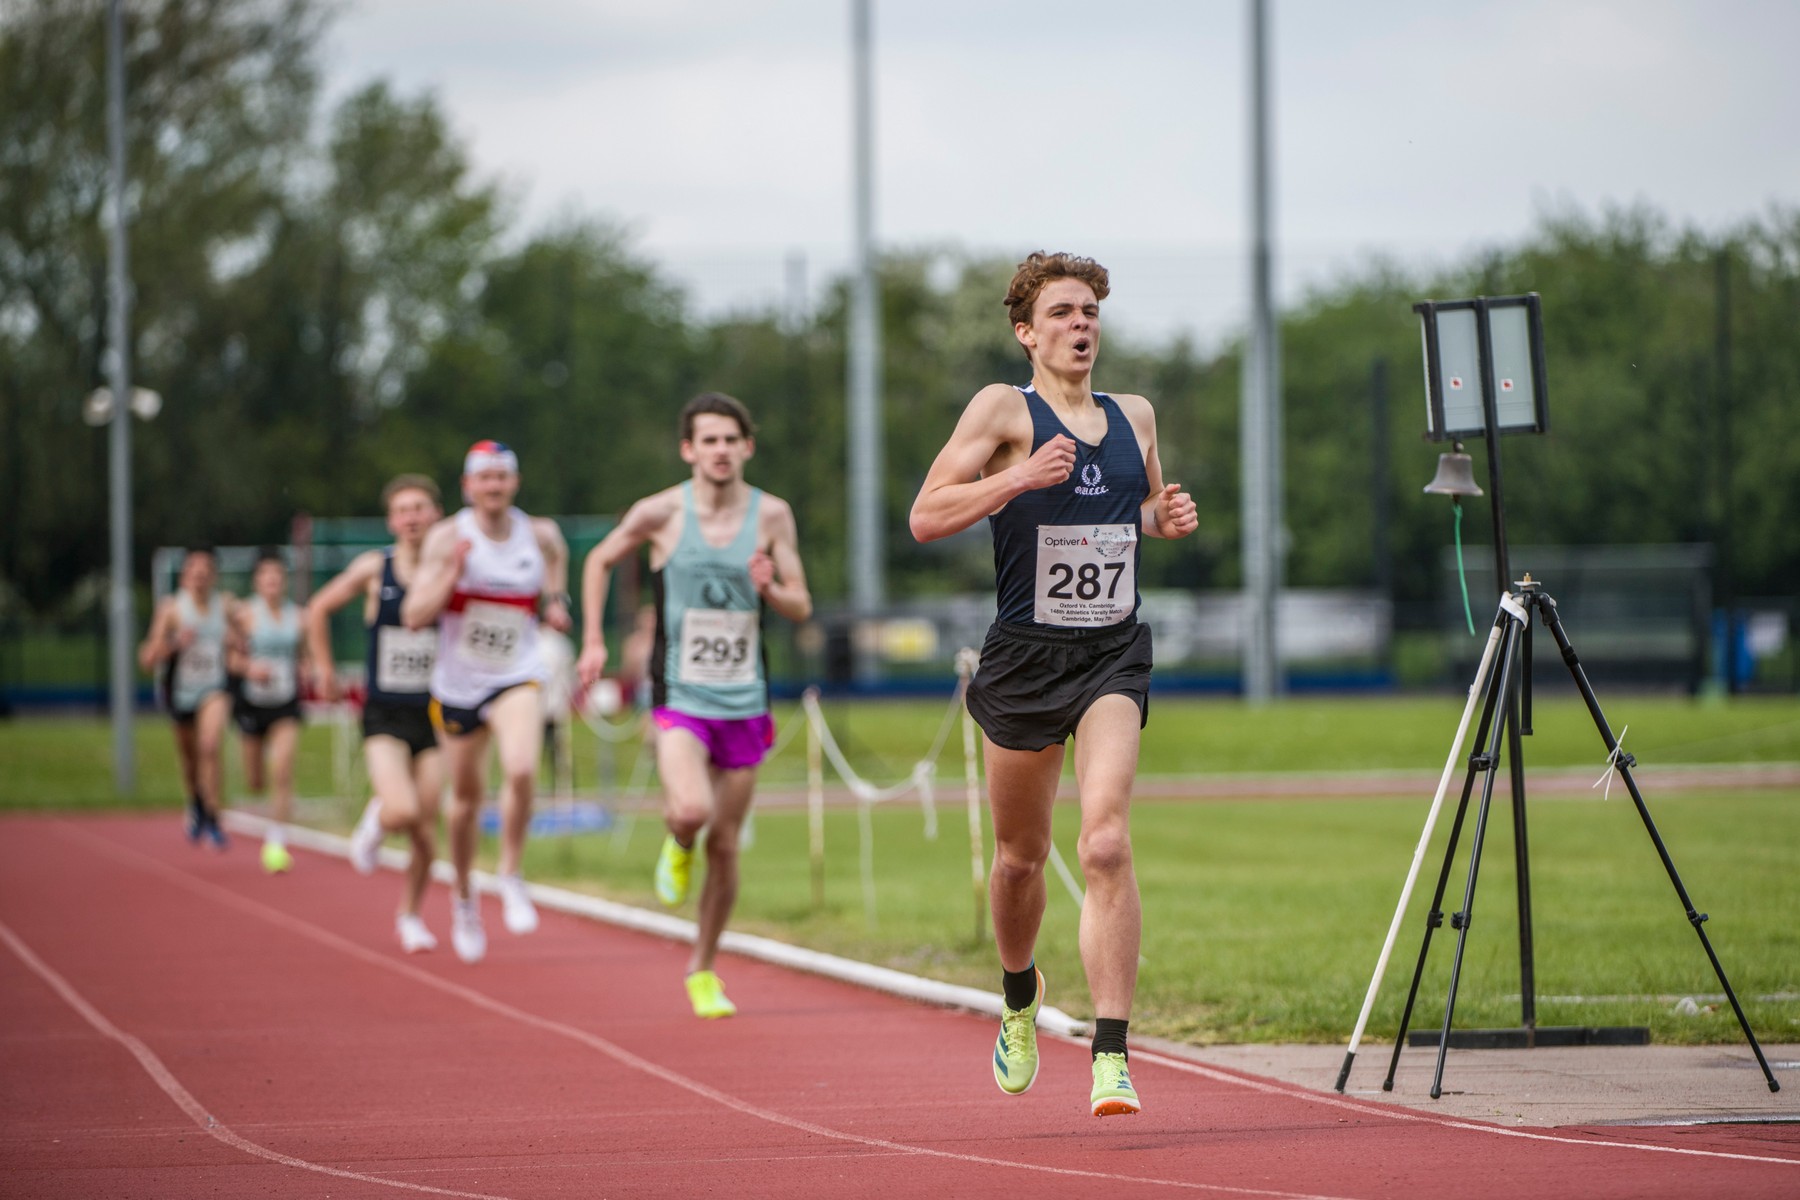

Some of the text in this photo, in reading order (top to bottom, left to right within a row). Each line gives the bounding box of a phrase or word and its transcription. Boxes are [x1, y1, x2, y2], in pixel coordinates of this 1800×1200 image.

[1045, 536, 1080, 548] Optiver
[1047, 562, 1126, 600] 287
[691, 636, 748, 665] 293
